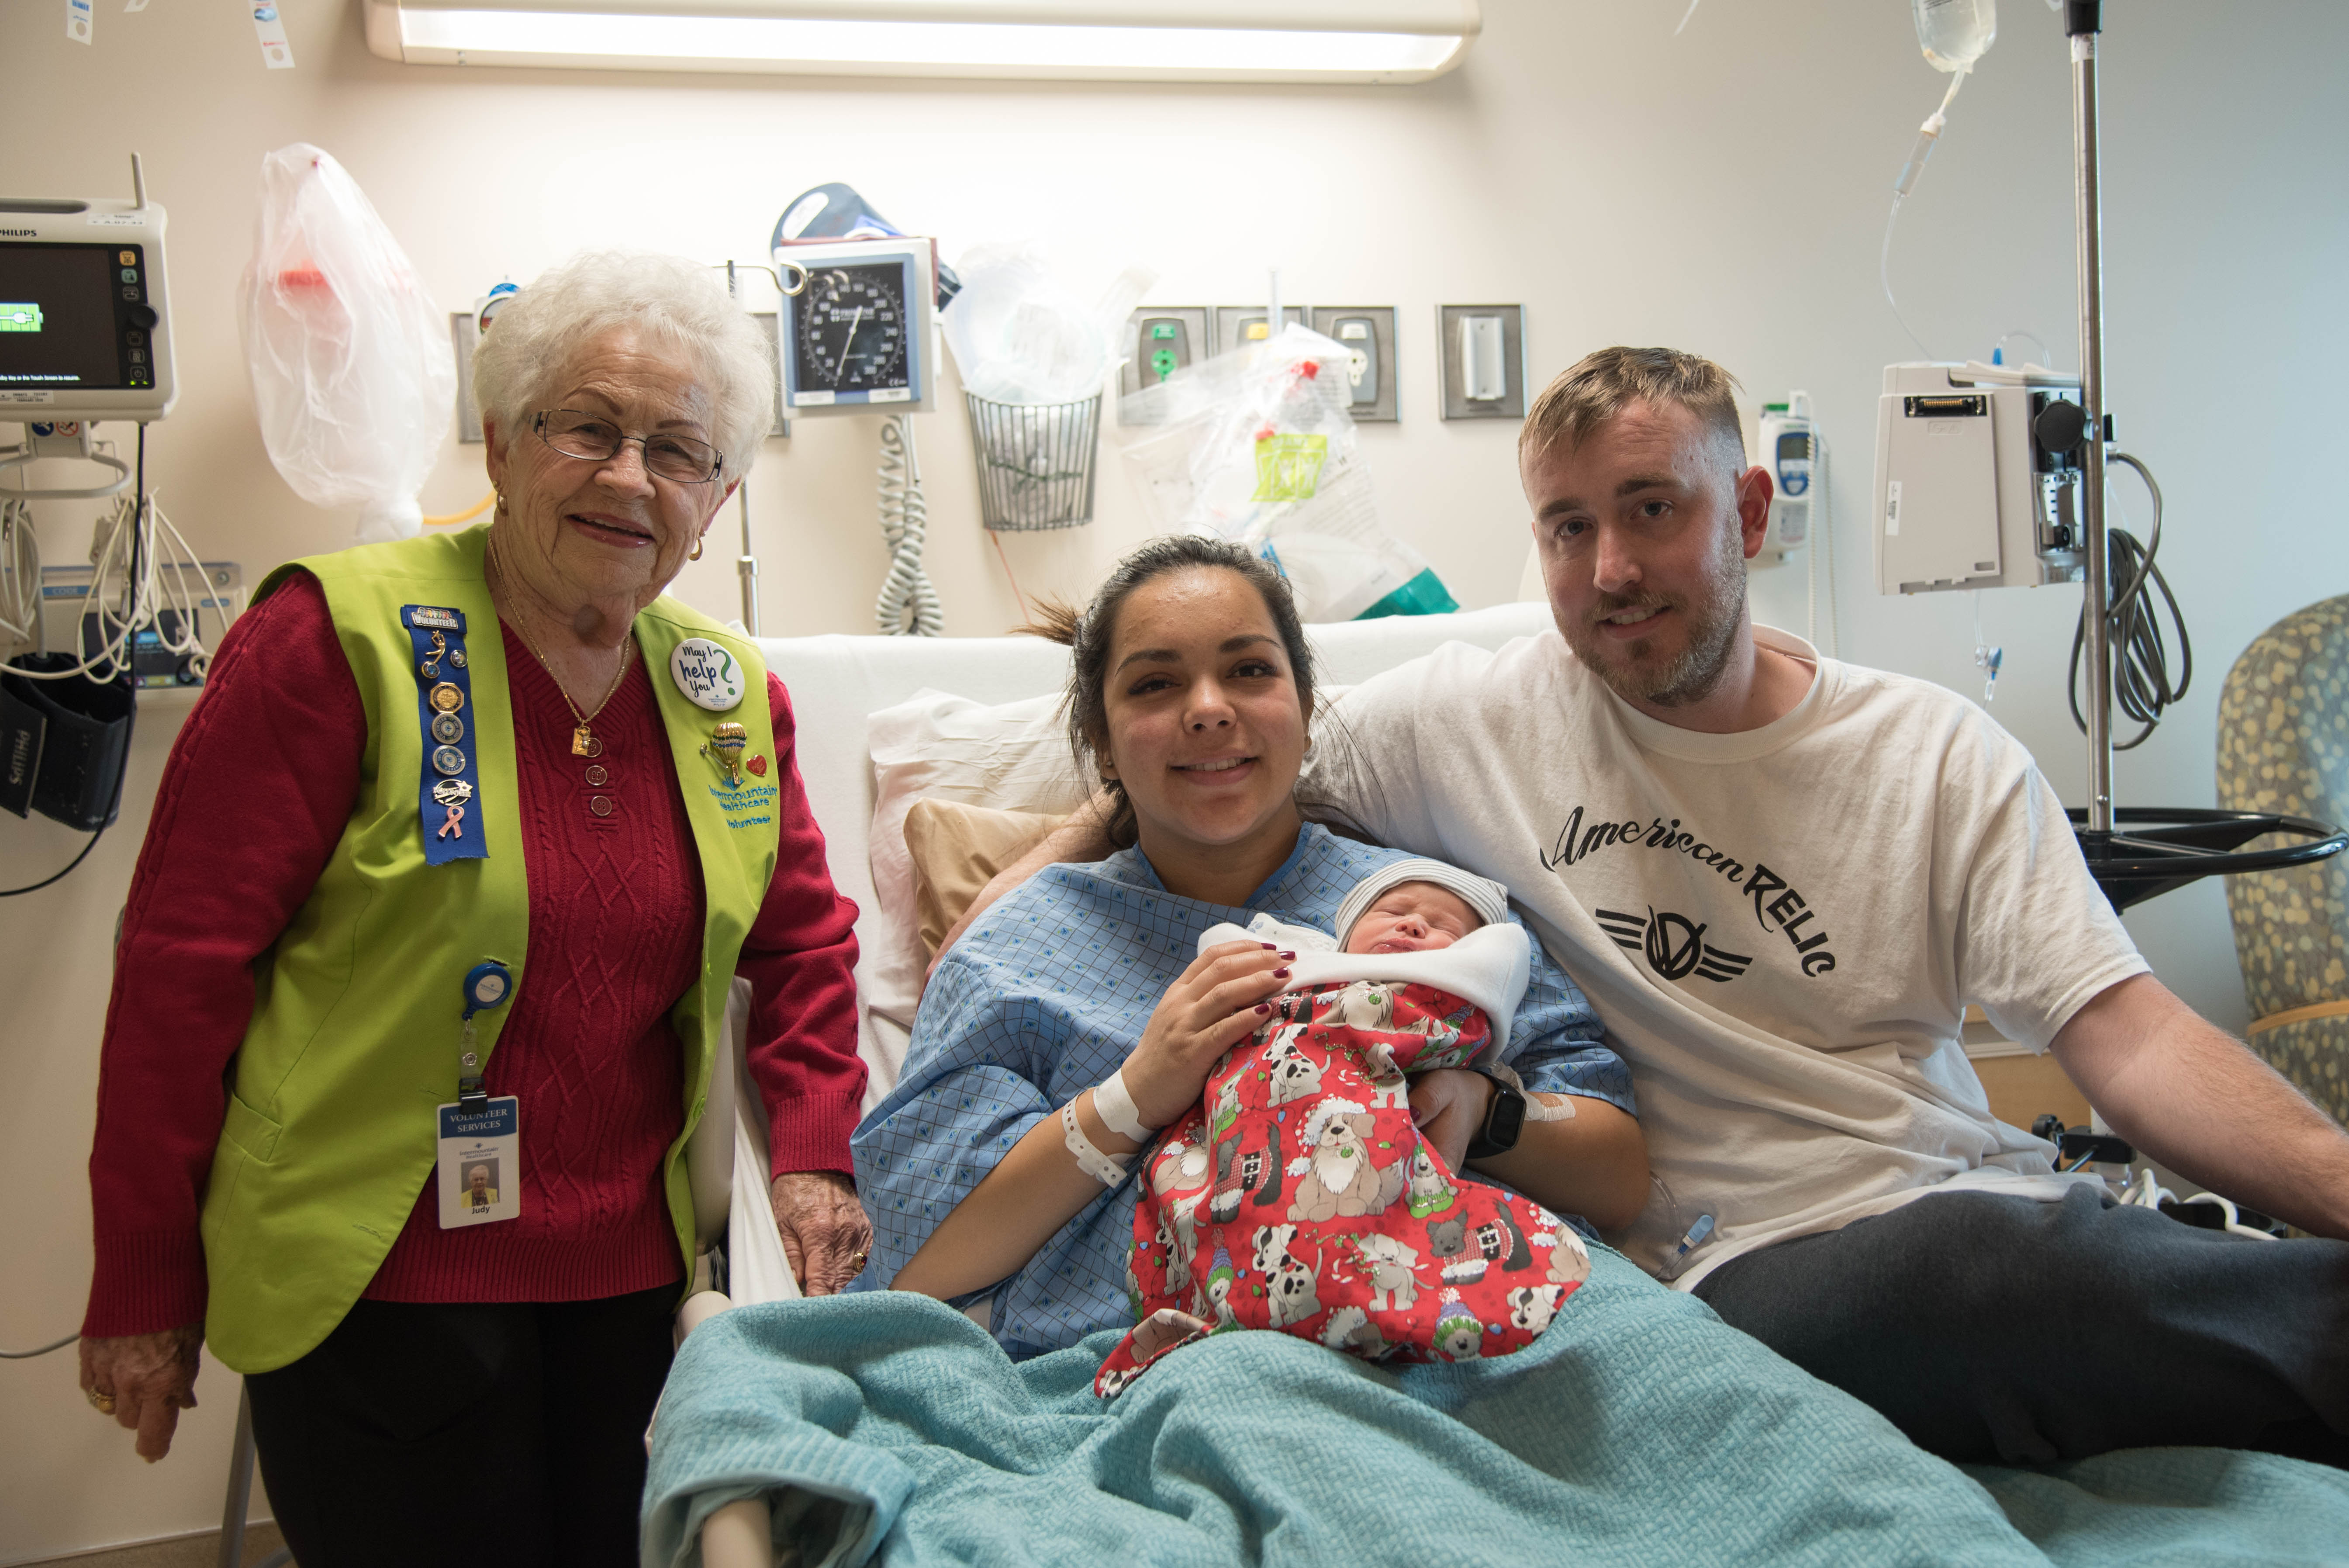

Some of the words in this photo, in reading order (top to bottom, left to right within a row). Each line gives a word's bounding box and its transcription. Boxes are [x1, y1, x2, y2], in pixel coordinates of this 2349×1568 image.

[413, 613, 457, 628] VOLUNTEER
[682, 646, 706, 662] May
[707, 646, 712, 657] I
[679, 658, 717, 687] help
[690, 680, 710, 698] You
[708, 785, 777, 801] Intermountain
[719, 798, 769, 811] Healthcare
[726, 816, 770, 829] Volunteer
[1540, 806, 1743, 882] American
[1743, 863, 1835, 977] RELIC
[450, 1109, 507, 1122] VOLUNTEER
[458, 1120, 501, 1132] SERVICES
[460, 1147, 498, 1156] Intermountain
[472, 1205, 490, 1214] Judy
